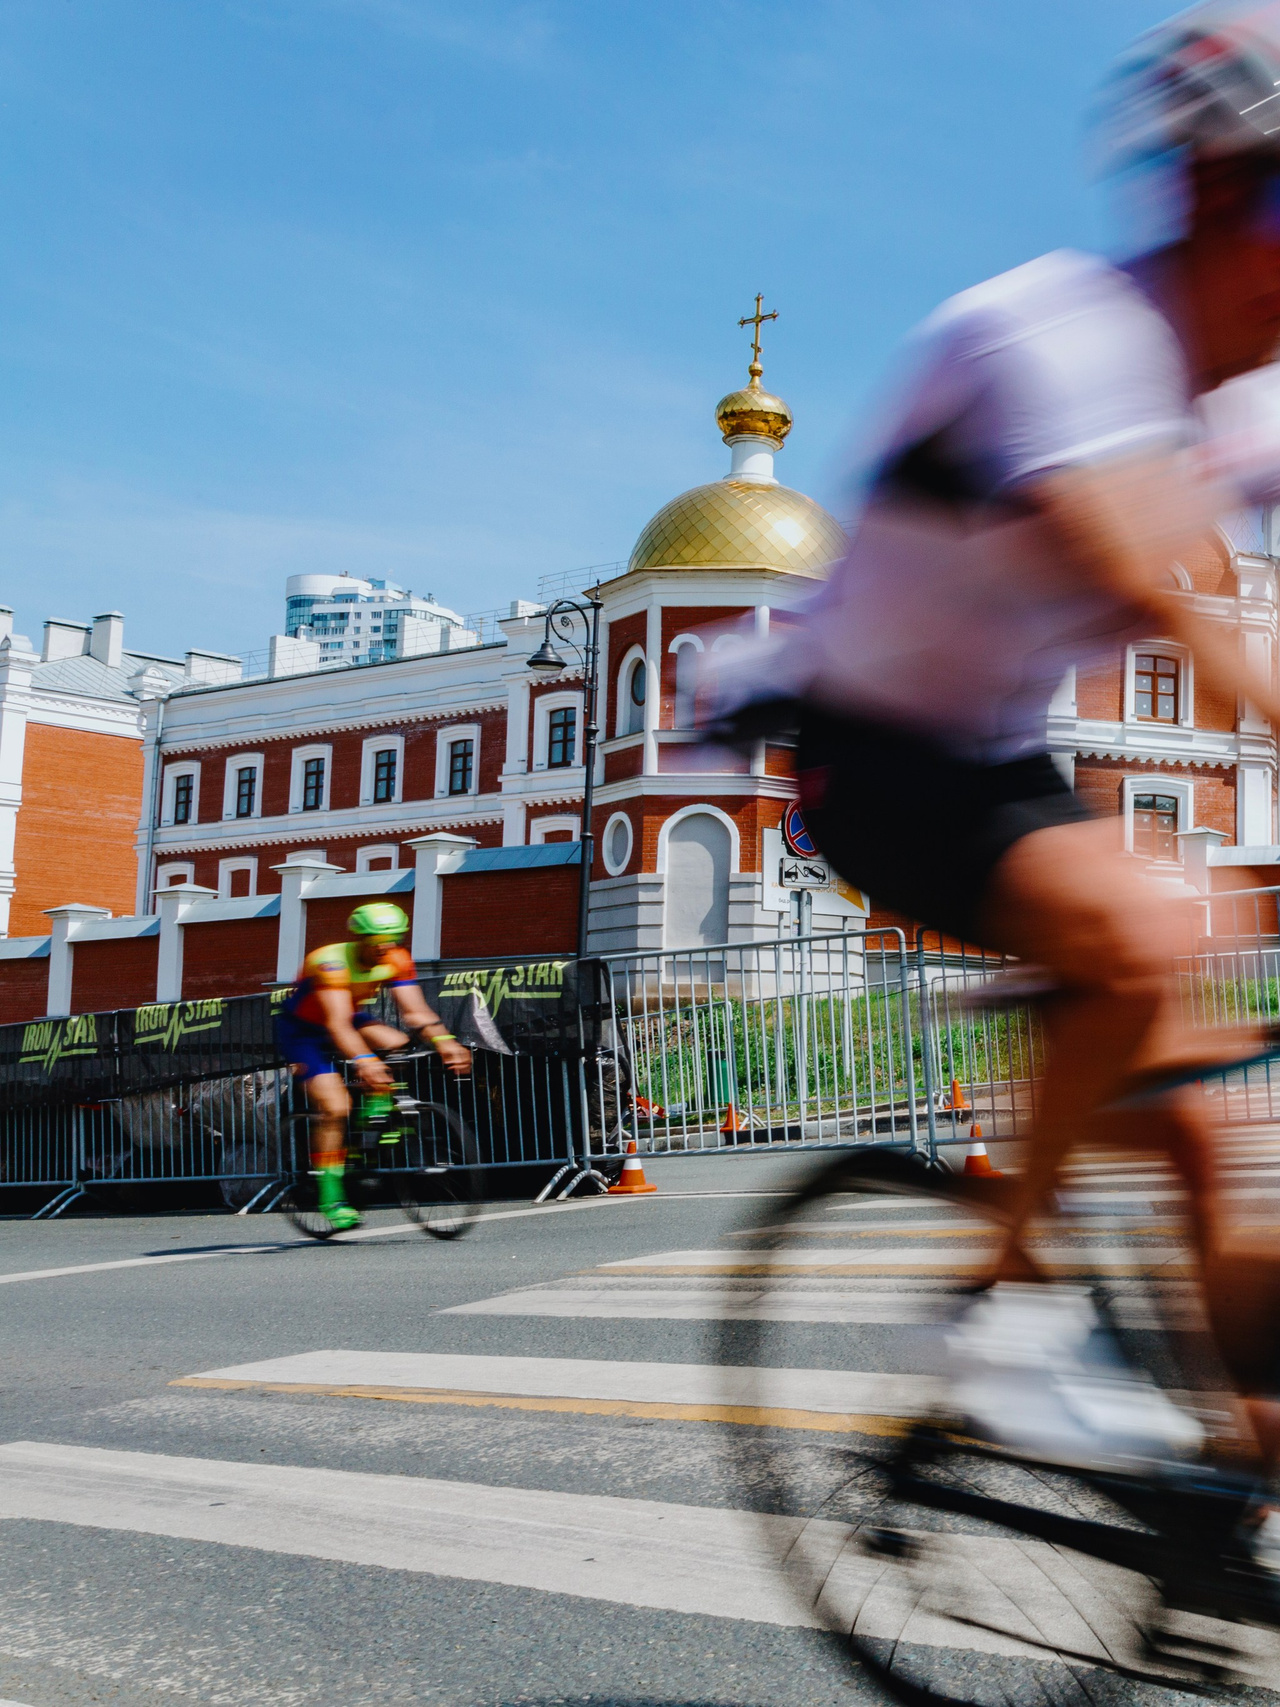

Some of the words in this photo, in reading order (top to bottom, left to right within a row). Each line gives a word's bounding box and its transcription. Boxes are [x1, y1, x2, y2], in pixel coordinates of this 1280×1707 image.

[22, 1021, 54, 1052] IRON
[63, 1014, 98, 1046] SAR
[135, 1003, 171, 1033] IRON
